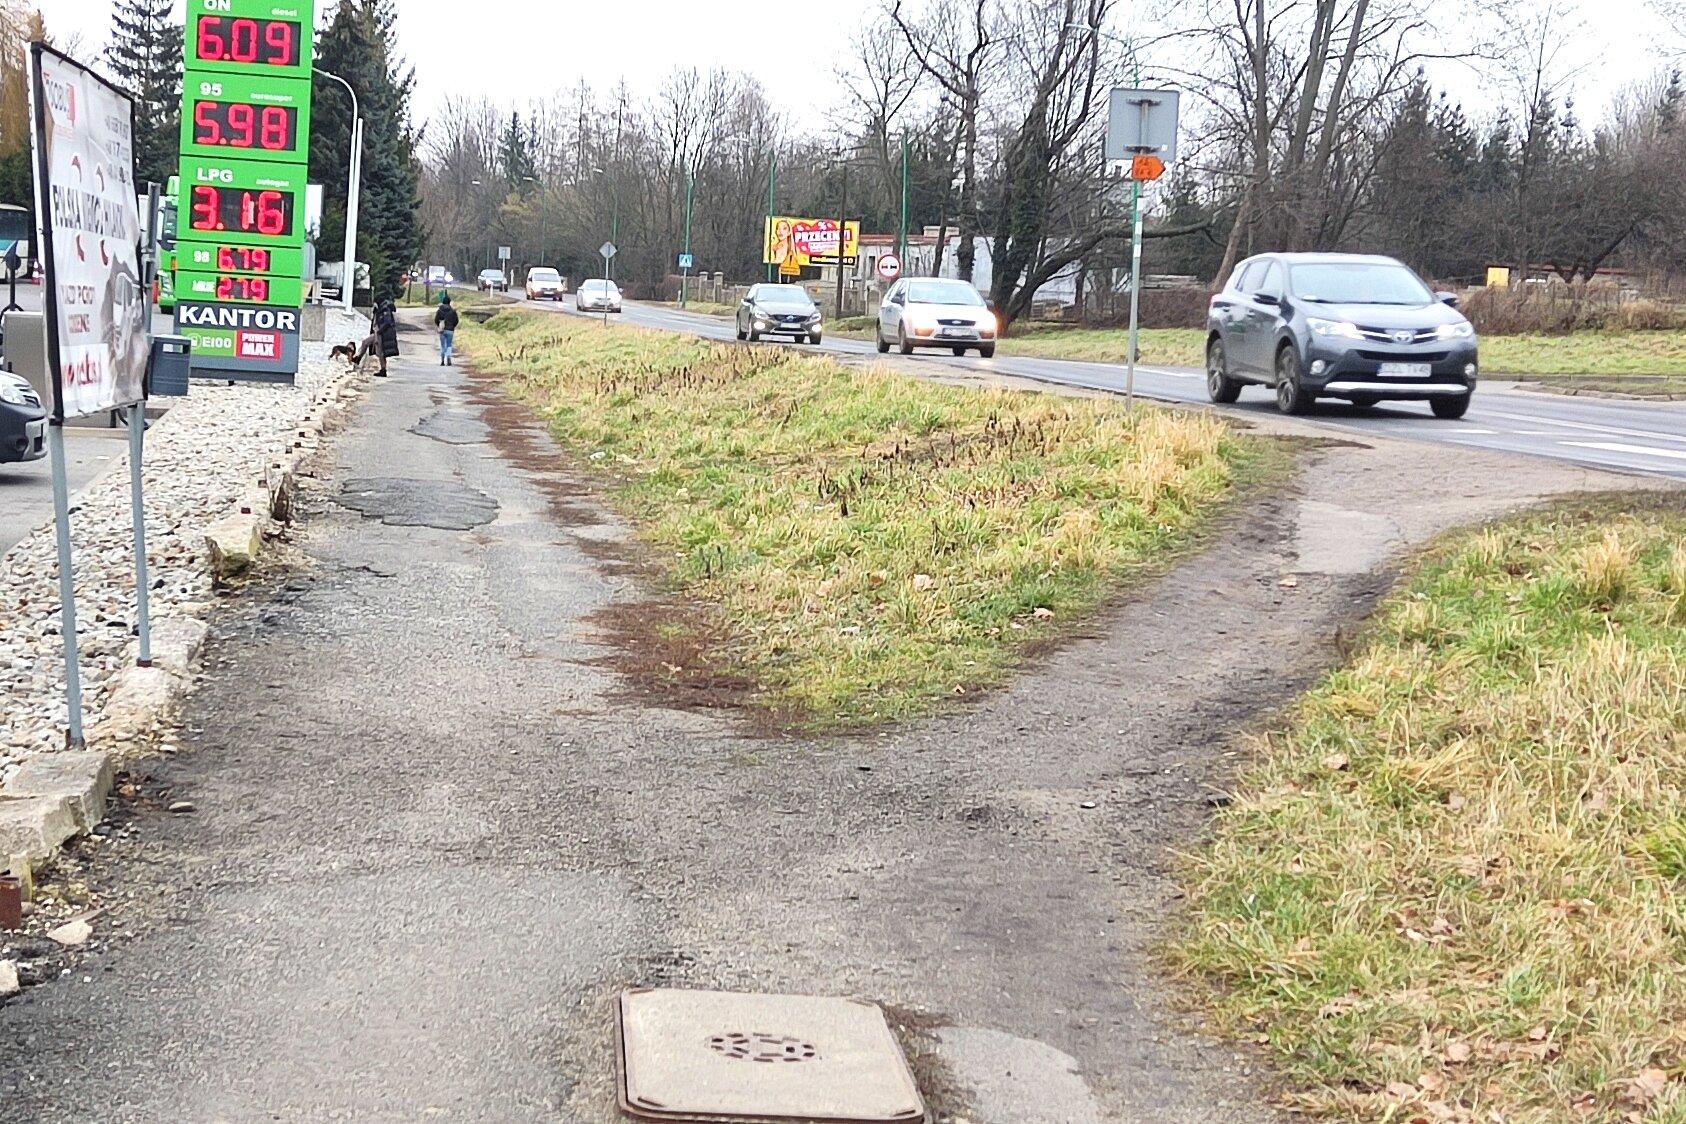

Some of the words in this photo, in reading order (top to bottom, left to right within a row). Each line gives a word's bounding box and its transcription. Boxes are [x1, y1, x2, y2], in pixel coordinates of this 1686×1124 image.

[203, 0, 231, 12] ON
[198, 16, 291, 65] 6.09
[199, 82, 223, 97] 95
[195, 101, 288, 150] 5.98
[197, 167, 233, 183] LPG
[192, 186, 285, 235] 3.16
[193, 250, 210, 263] 98
[179, 305, 296, 330] KANTOR
[202, 336, 232, 349] E100
[241, 332, 275, 343] POWER
[241, 343, 275, 357] MAX
